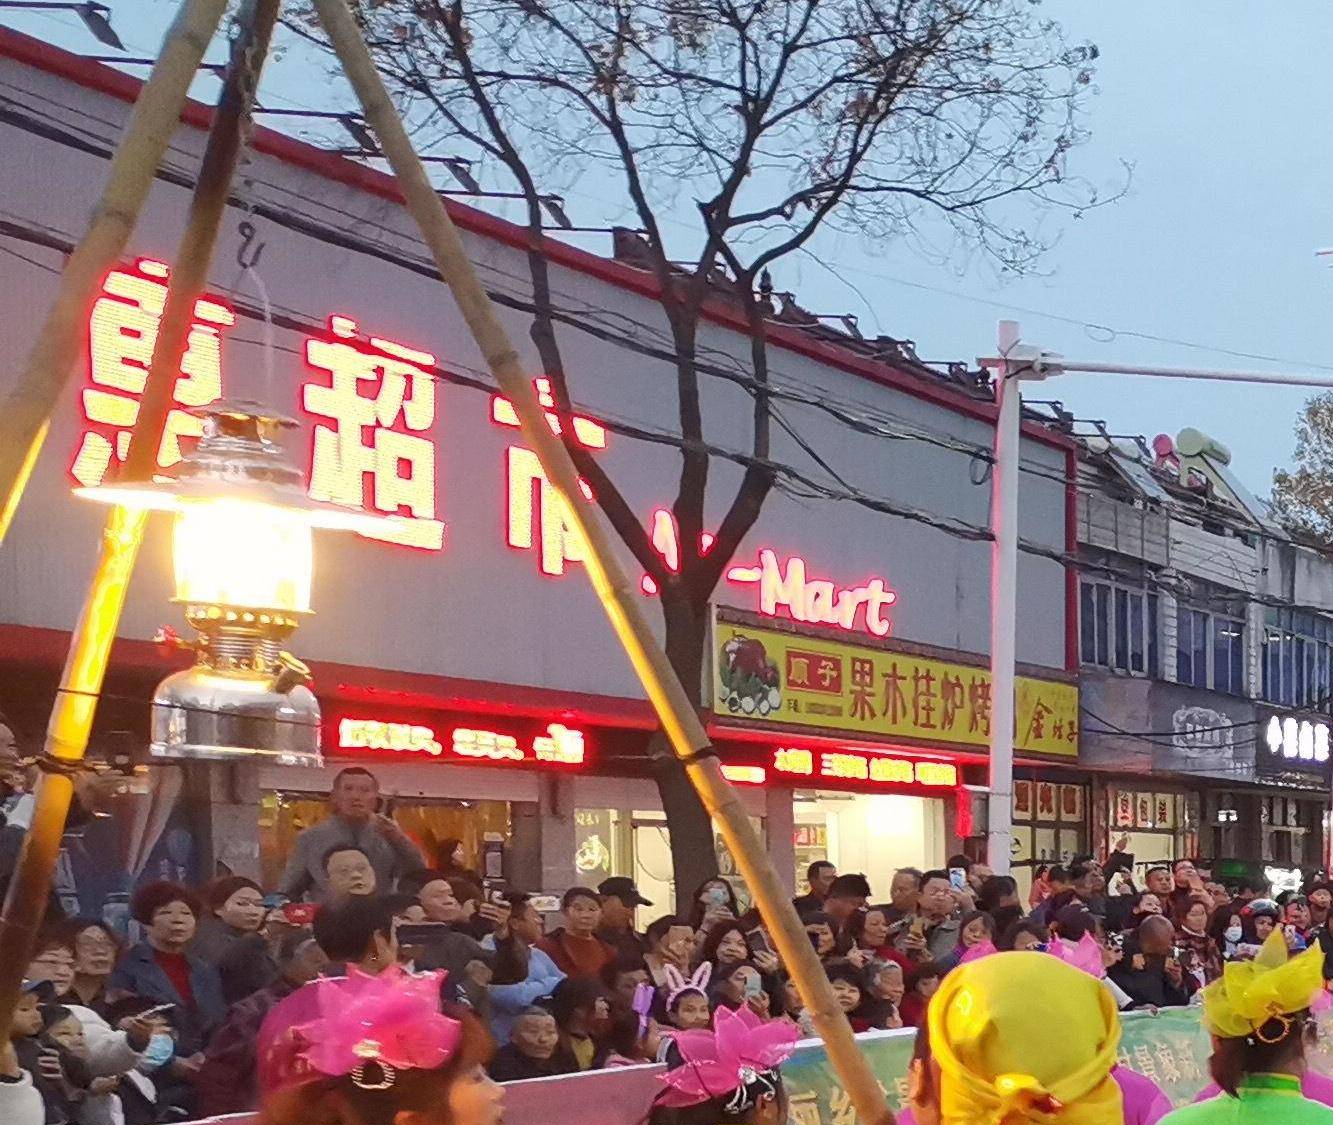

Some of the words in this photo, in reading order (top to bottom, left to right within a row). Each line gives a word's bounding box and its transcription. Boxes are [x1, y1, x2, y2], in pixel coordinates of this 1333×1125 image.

[849, 656, 1015, 740] 果木挂炉烤
